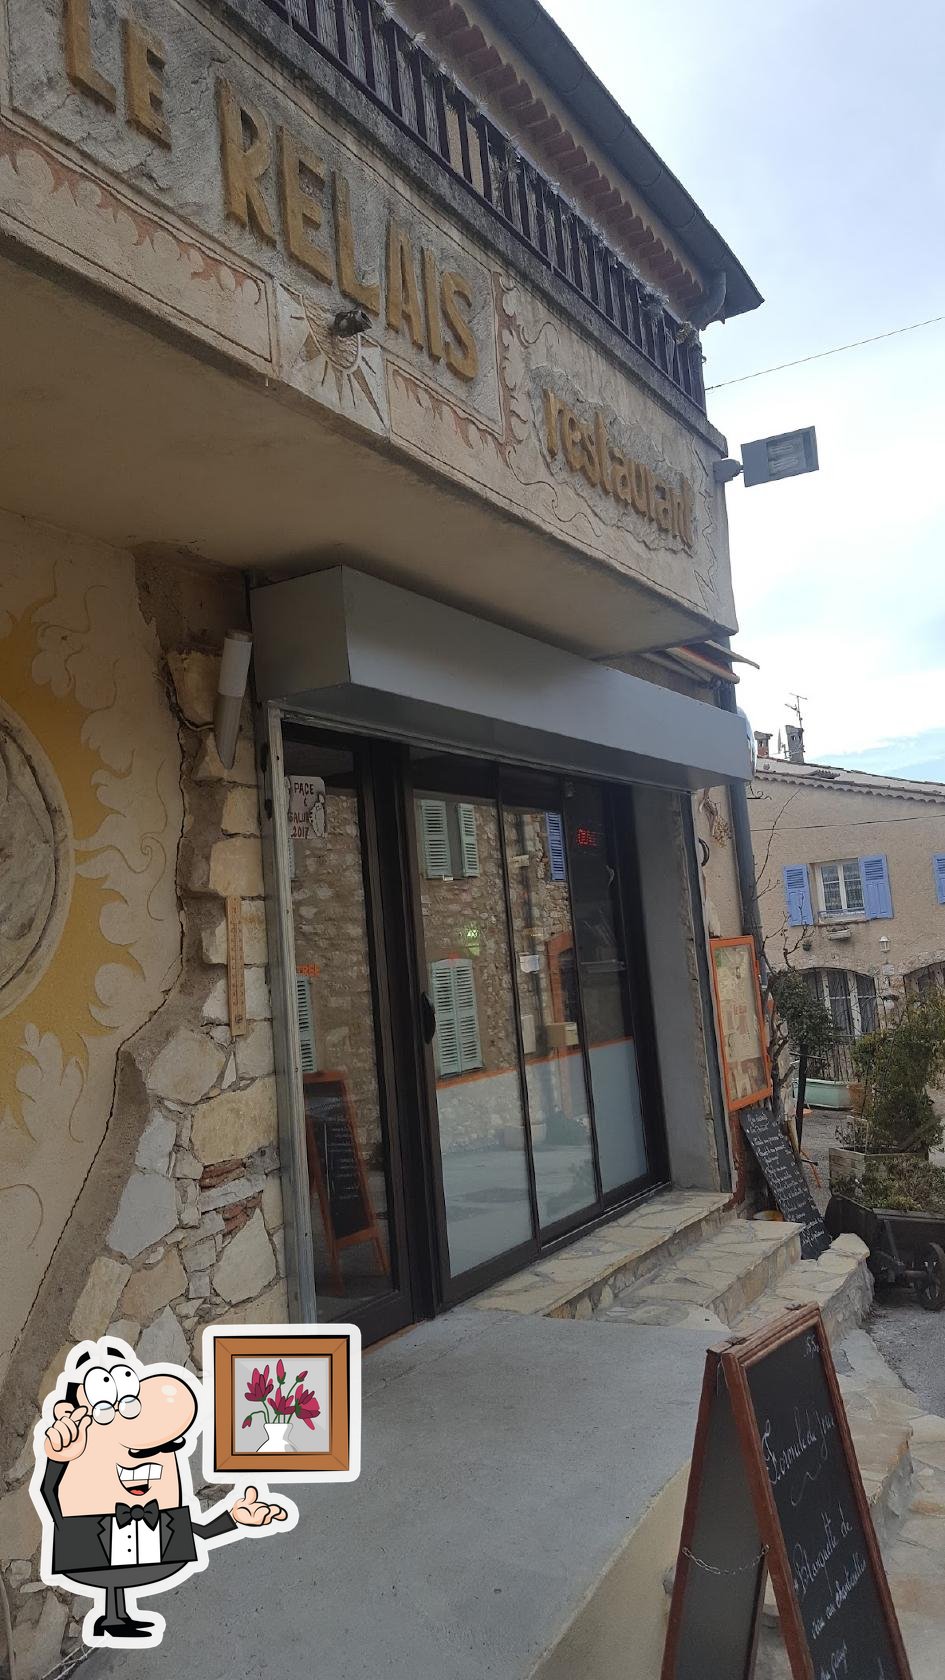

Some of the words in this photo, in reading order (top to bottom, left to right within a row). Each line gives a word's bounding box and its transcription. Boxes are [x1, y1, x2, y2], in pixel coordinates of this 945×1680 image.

[63, 0, 171, 150] LE
[214, 76, 478, 381] RELAIS
[541, 387, 694, 550] restaurant
[290, 825, 310, 839] 2017
[294, 782, 314, 796] PACE
